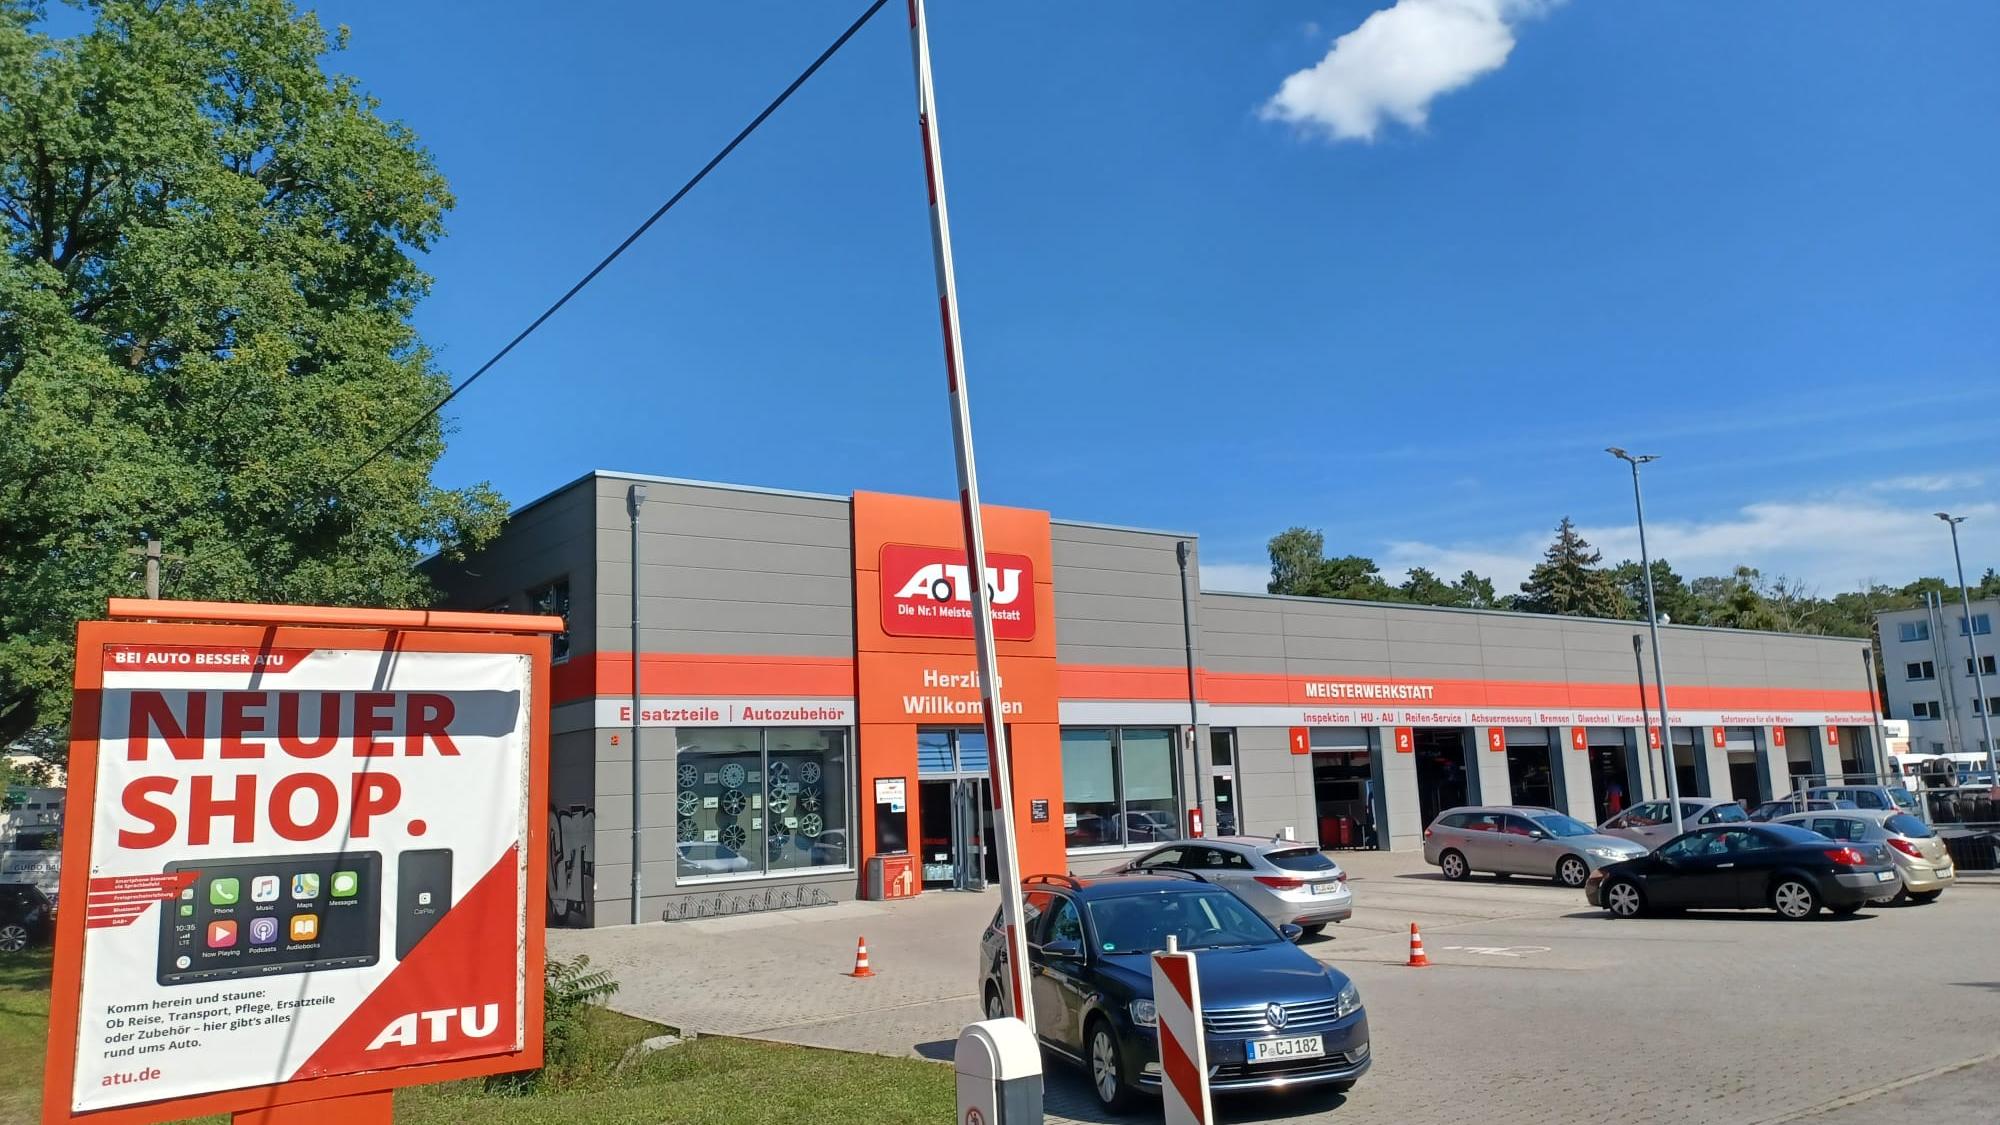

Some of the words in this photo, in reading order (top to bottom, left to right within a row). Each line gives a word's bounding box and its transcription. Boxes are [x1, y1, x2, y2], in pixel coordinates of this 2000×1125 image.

[894, 563, 1022, 604] ATU
[898, 605, 914, 615] Die
[939, 606, 1020, 620] Meistekstatt
[115, 652, 141, 664] BEI
[145, 652, 191, 665] AUTO
[195, 653, 250, 665] BESSER
[254, 654, 284, 666] ATU
[923, 669, 1003, 688] Herzli
[1305, 682, 1434, 700] MEISTERWERKSTATT
[619, 706, 719, 721] Esatzteile
[742, 706, 844, 721] Autozubehör
[903, 696, 1023, 714] Willkomen
[127, 691, 461, 761] NEUER
[1304, 712, 1350, 725] Inspektion
[1360, 713, 1374, 723] HU
[1382, 713, 1394, 723] AU
[1405, 712, 1462, 723] Reifen-Service
[1471, 713, 1532, 725] Achsvermessung
[118, 772, 427, 849] SHOP.
[297, 901, 313, 909] Maps
[329, 899, 358, 907] Messages
[218, 949, 241, 957] Playing
[249, 946, 277, 954] Podcasts
[286, 942, 320, 951] Audiobooks
[107, 1003, 149, 1015] Komm
[152, 997, 192, 1010] herein
[196, 993, 219, 1005] und
[222, 989, 265, 1003] staune:
[106, 1018, 124, 1029] Ob
[128, 1015, 165, 1028] Reise,
[168, 1008, 231, 1023] Transport,
[235, 1002, 273, 1016] Pflege,
[276, 995, 336, 1010] Ersatzteile
[104, 1032, 135, 1044] oder
[138, 1025, 191, 1040] Zubehör
[203, 1020, 228, 1032] hier
[264, 1013, 291, 1025] alles
[365, 1003, 499, 1051] ATU
[104, 1046, 135, 1059] rund
[138, 1043, 166, 1054] ums
[168, 1037, 202, 1050] Auto.
[102, 1067, 161, 1087] atu.de
